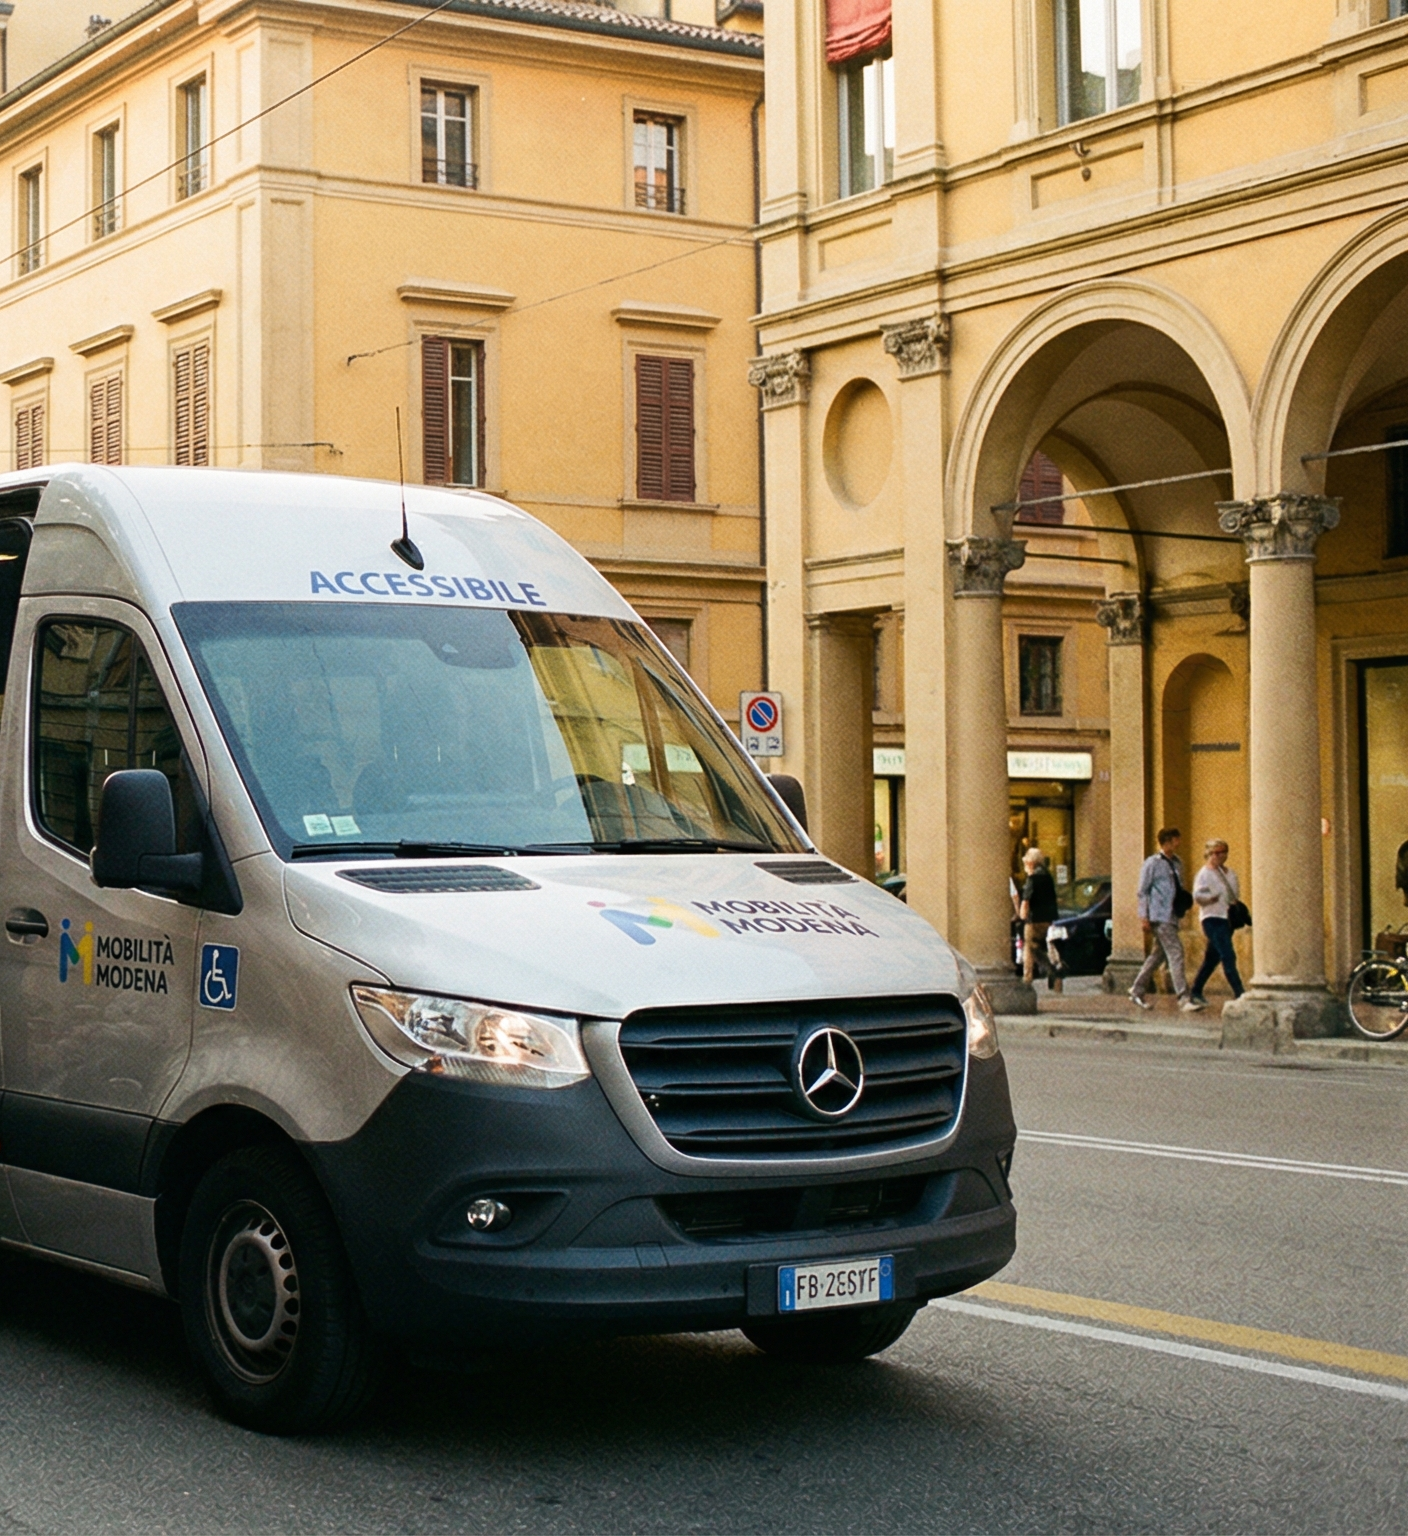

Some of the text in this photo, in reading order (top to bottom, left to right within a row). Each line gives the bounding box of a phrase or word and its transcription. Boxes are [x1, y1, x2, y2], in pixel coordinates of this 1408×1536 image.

[310, 571, 547, 606] ACCESSIBILE
[691, 899, 861, 920] MOBILITÀ
[720, 918, 880, 938] MODENA
[97, 934, 174, 965] MOBILITÀ
[96, 965, 168, 994] MODENA
